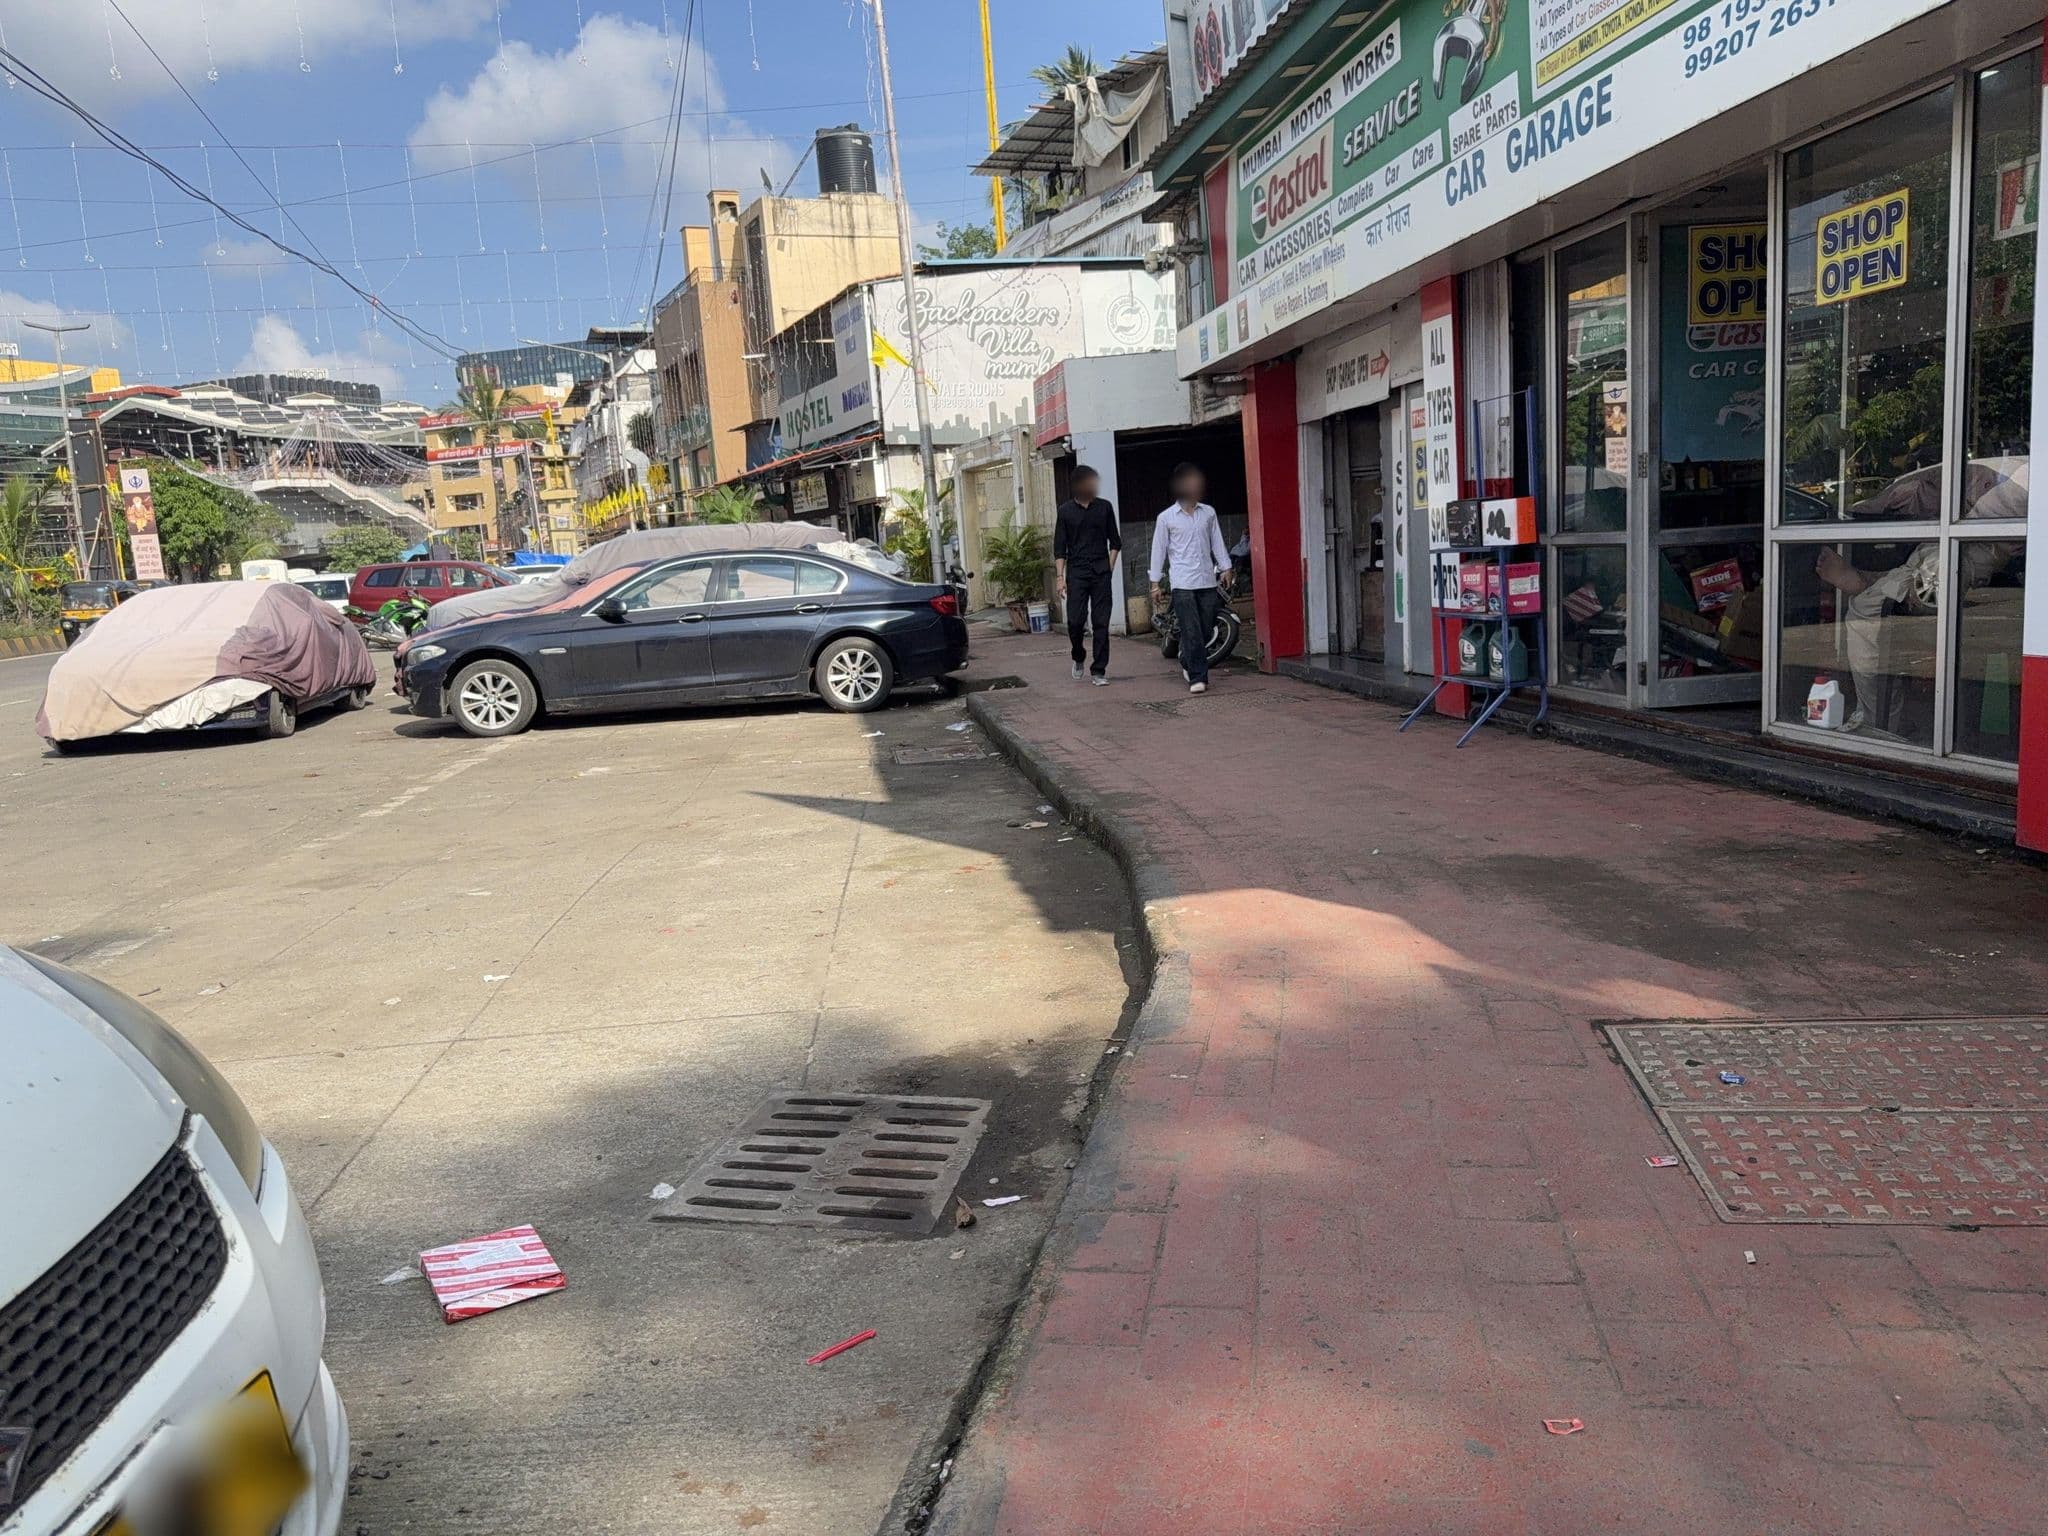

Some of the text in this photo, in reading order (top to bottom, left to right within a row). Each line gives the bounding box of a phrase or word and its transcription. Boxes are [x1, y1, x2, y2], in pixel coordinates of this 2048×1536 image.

[1549, 29, 1566, 48] Types
[1574, 11, 1587, 28] Car
[1683, 16, 1711, 50] 98
[1685, 20, 1760, 79] 99207
[1243, 33, 1395, 181] MUMBAI MOTOR WORKS
[1343, 78, 1420, 167] SERVICE
[1452, 100, 1517, 155] SPARE PARTS
[1472, 92, 1492, 119] CAR
[1446, 73, 1613, 206] CAR GARAGE
[1268, 136, 1328, 227] Castrol
[1338, 143, 1434, 216] Complete Car Care
[1240, 209, 1331, 286] CAR ACCESSORIES
[1365, 203, 1411, 248] कार गेराज
[1821, 198, 1904, 257] SHOP
[1821, 241, 1903, 297] OPEN
[897, 288, 1059, 341] Backpackers
[977, 327, 1042, 360] Villa
[1430, 326, 1445, 367] ALL
[1689, 360, 1765, 379] CAR C
[786, 395, 833, 439] HOSTEL
[1427, 386, 1452, 428] TYPES
[1433, 447, 1450, 485] CAR
[1433, 564, 1458, 600] PRTS
